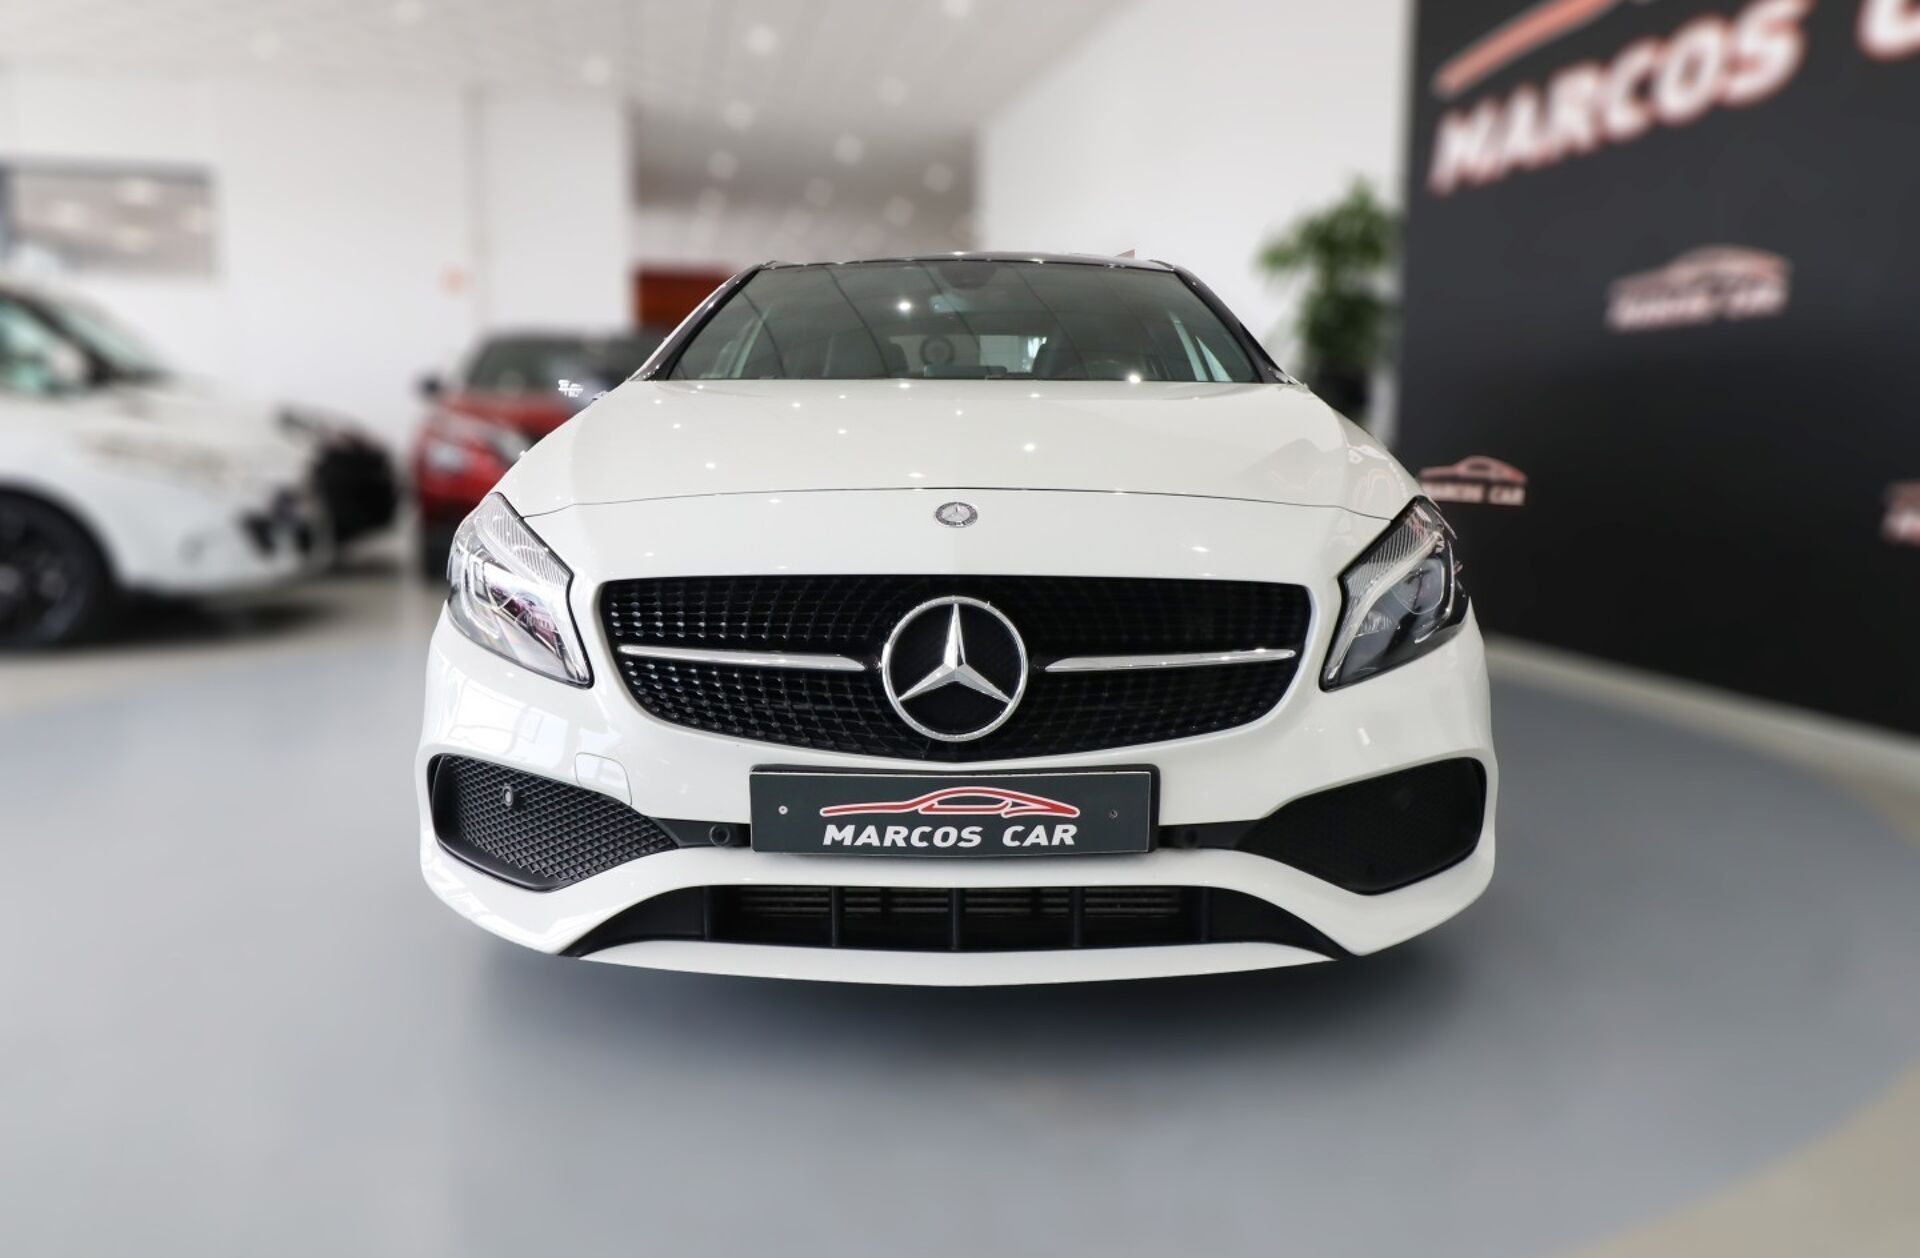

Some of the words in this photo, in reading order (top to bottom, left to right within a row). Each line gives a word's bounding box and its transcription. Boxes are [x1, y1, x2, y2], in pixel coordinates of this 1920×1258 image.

[1430, 0, 1811, 194] MARCOS
[823, 824, 983, 847] MARCOS
[1002, 824, 1077, 846] CAR
